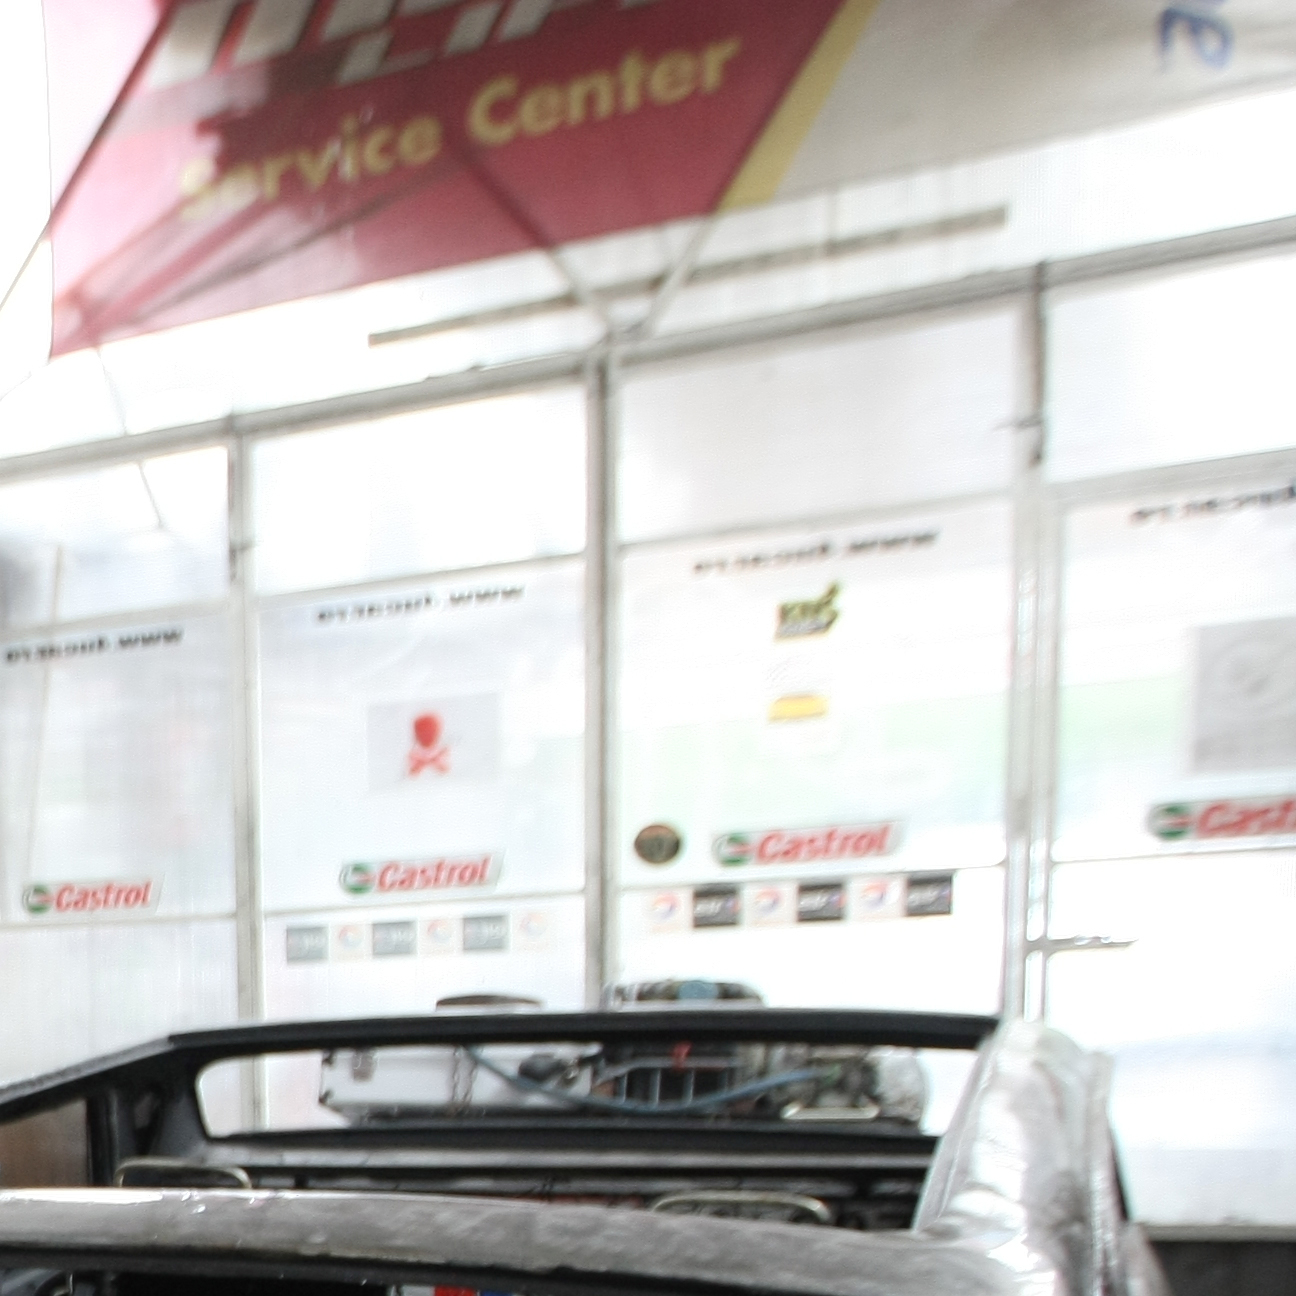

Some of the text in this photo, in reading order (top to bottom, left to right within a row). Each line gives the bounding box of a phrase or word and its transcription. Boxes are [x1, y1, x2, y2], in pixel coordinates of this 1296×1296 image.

[467, 37, 742, 146] Center
[756, 823, 892, 863] Castrol
[376, 855, 491, 894] Castrol
[54, 880, 154, 914] Castrol
